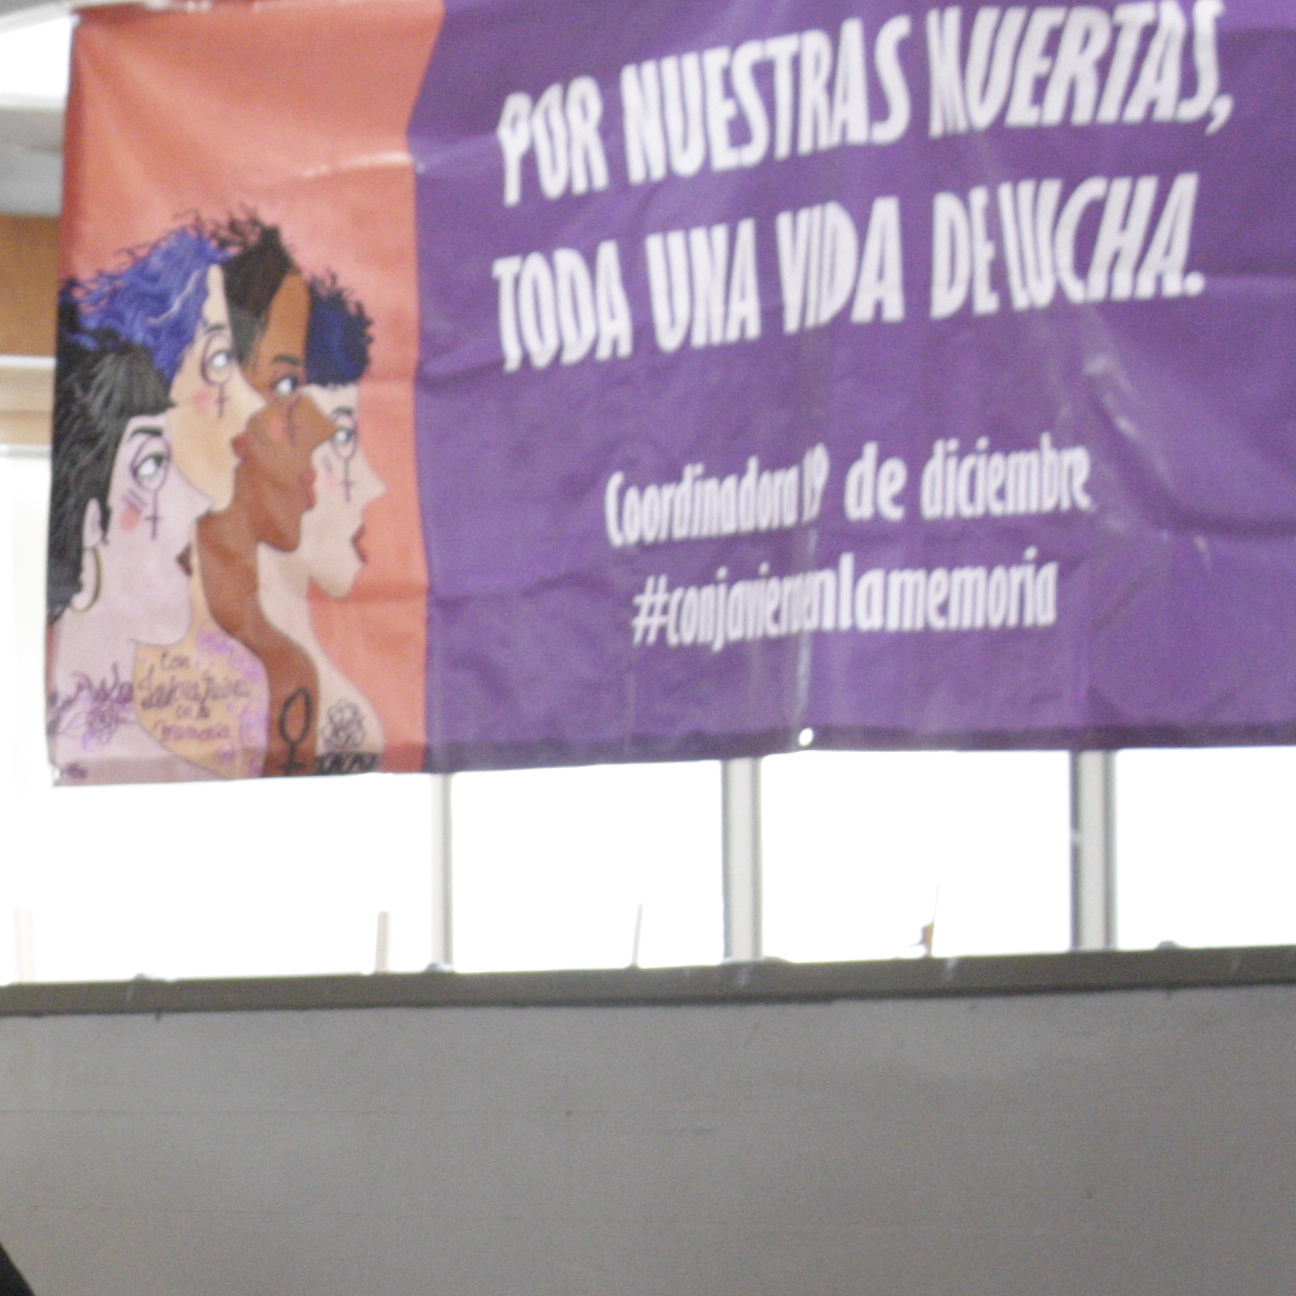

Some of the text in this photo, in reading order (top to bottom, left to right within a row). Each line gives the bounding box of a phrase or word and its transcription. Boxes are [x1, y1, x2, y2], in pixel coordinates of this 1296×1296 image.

[495, 0, 1234, 208] POR NUESTRAS MUERTAS,
[490, 239, 634, 374] TODA
[643, 217, 763, 354] UNA
[774, 196, 906, 335] VIDA
[929, 186, 1001, 321] DE
[603, 454, 801, 549] Coordinadora
[842, 441, 909, 523] de
[919, 431, 1096, 521] diciembre
